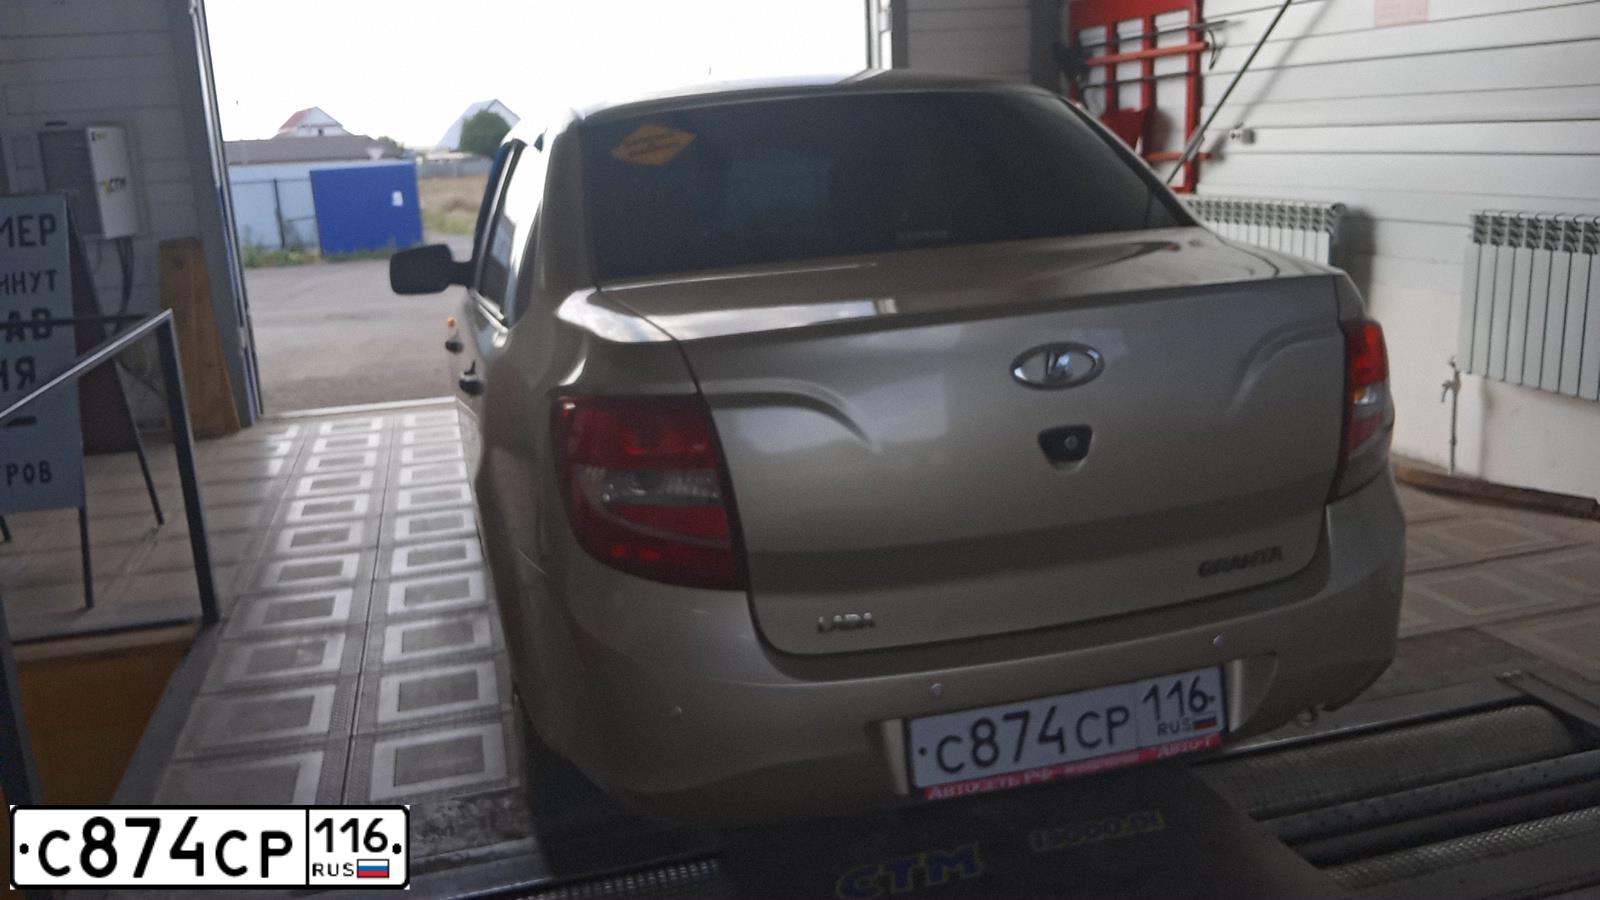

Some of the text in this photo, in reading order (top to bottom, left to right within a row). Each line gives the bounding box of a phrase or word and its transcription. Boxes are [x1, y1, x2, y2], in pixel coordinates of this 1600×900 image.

[935, 705, 1130, 774] С874СР
[1143, 675, 1208, 722] 116
[1157, 717, 1192, 737] RUS
